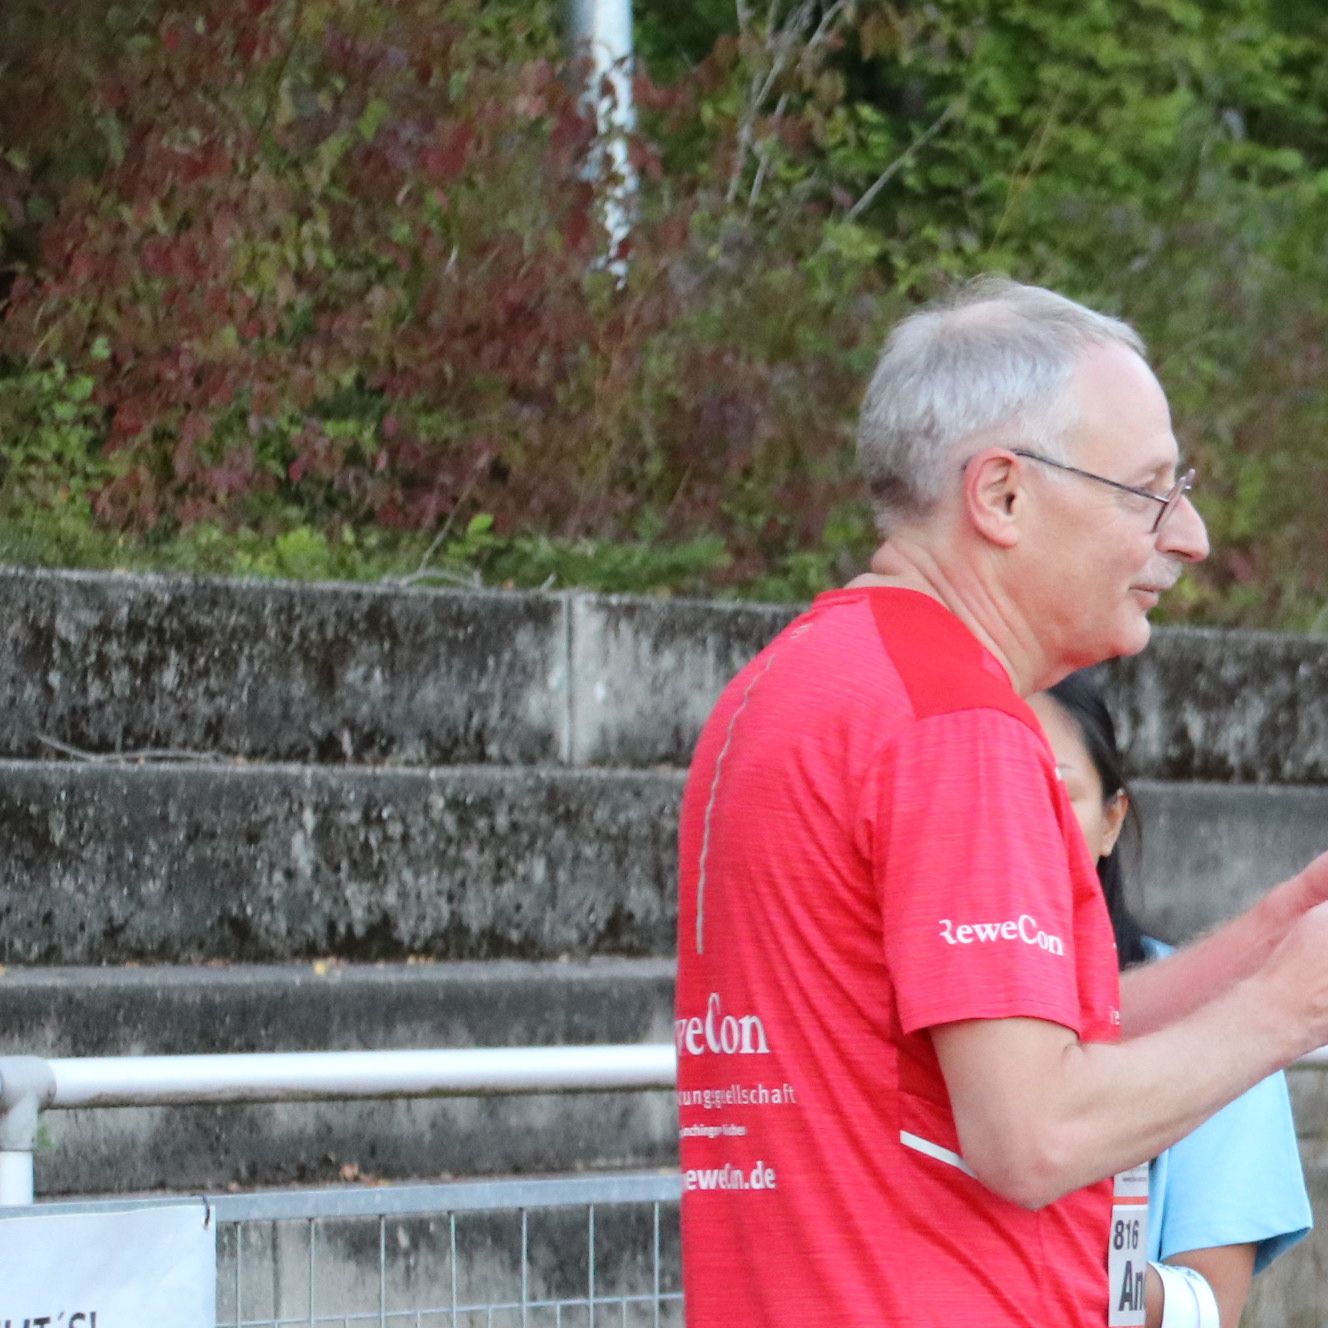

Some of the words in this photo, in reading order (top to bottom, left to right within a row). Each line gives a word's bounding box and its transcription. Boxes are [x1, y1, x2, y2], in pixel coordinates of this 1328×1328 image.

[939, 914, 1064, 956] ReweCon
[1113, 1219, 1140, 1251] 816
[1118, 1260, 1145, 1312] An
